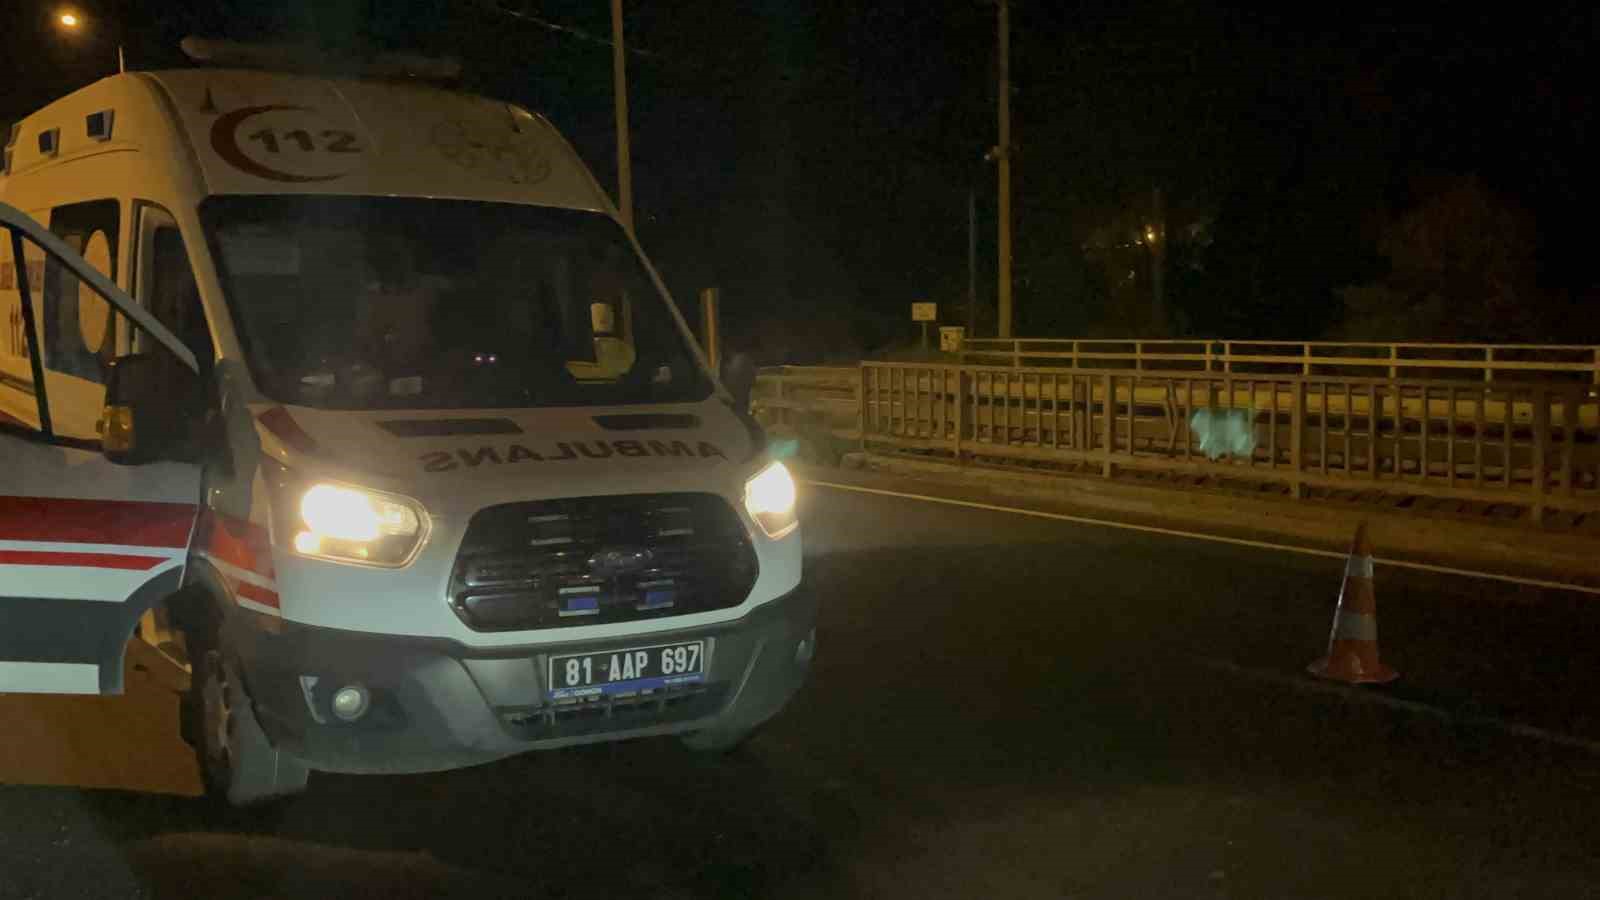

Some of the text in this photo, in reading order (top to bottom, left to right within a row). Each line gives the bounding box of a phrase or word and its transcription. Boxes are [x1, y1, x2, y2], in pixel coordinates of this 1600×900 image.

[248, 128, 362, 153] 112
[565, 645, 700, 687] 81 AAP 697
